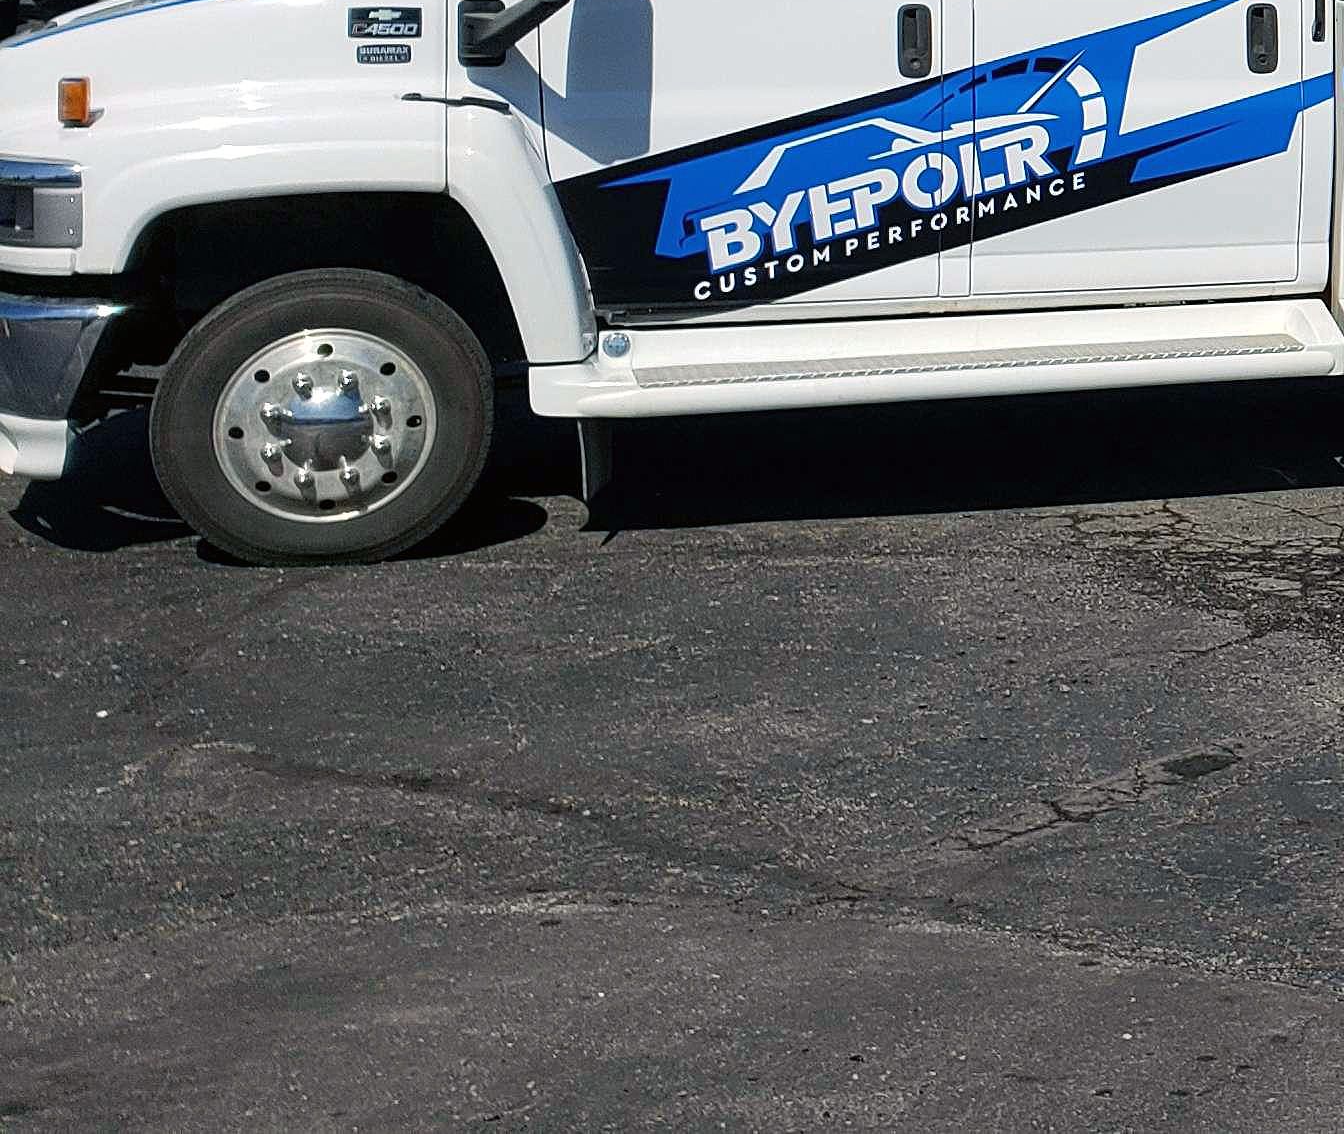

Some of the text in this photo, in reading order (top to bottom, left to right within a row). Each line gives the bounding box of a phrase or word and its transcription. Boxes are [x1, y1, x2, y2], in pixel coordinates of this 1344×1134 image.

[351, 22, 419, 36] C4500
[694, 171, 1086, 300] CUSTOM PERFORMANCE
[700, 123, 1054, 271] BYEPOLR
